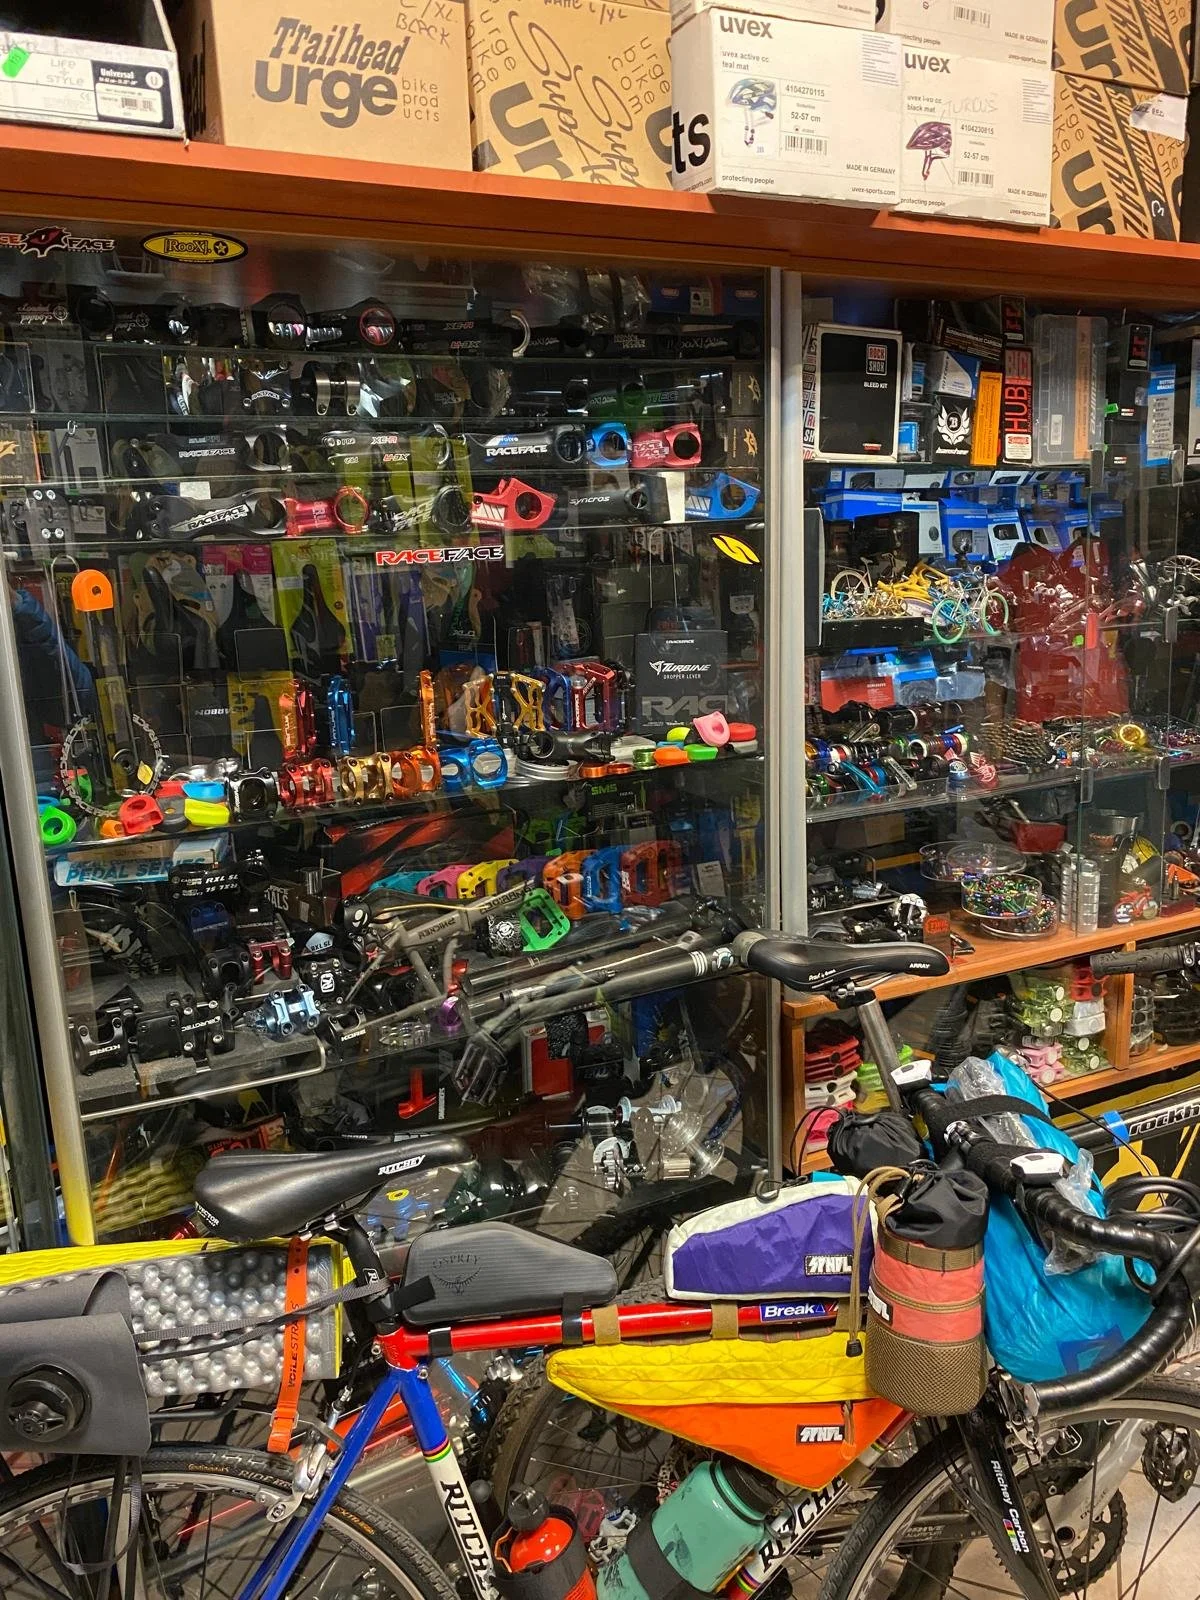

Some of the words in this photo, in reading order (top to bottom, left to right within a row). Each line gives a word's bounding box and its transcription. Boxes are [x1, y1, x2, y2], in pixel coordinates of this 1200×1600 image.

[719, 15, 773, 39] uvex
[921, 37, 941, 46] people
[1004, 32, 1019, 40] MADE
[269, 16, 411, 75] Trailhead
[740, 52, 760, 61] active
[904, 52, 951, 74] uvex
[722, 60, 735, 69] teal
[100, 67, 135, 79] Universal
[402, 76, 438, 94] bike
[255, 60, 398, 129] urge
[403, 93, 439, 108] prod
[404, 108, 440, 122] ucts
[846, 163, 861, 171] MADE
[869, 166, 896, 175] GERMANY
[722, 174, 753, 185] protecting
[754, 177, 775, 185] people
[851, 186, 896, 196] uvex-sports.com
[900, 197, 927, 207] protecting
[928, 199, 946, 207] people
[68, 238, 116, 250] FACE
[486, 444, 548, 457] RACEFACE
[375, 545, 503, 566] RACEFACE
[661, 662, 712, 672] TURBINE
[591, 784, 618, 796] SMS
[66, 863, 127, 884] PEDAL
[340, 1029, 367, 1042] KORE
[377, 1155, 426, 1176] RITCHEY
[198, 1204, 220, 1226] VECTOR
[432, 1253, 481, 1269] OSPREY
[291, 1303, 301, 1353] STRAS
[990, 1460, 1013, 1506] Ritchey
[1009, 1508, 1030, 1553] Carbon
